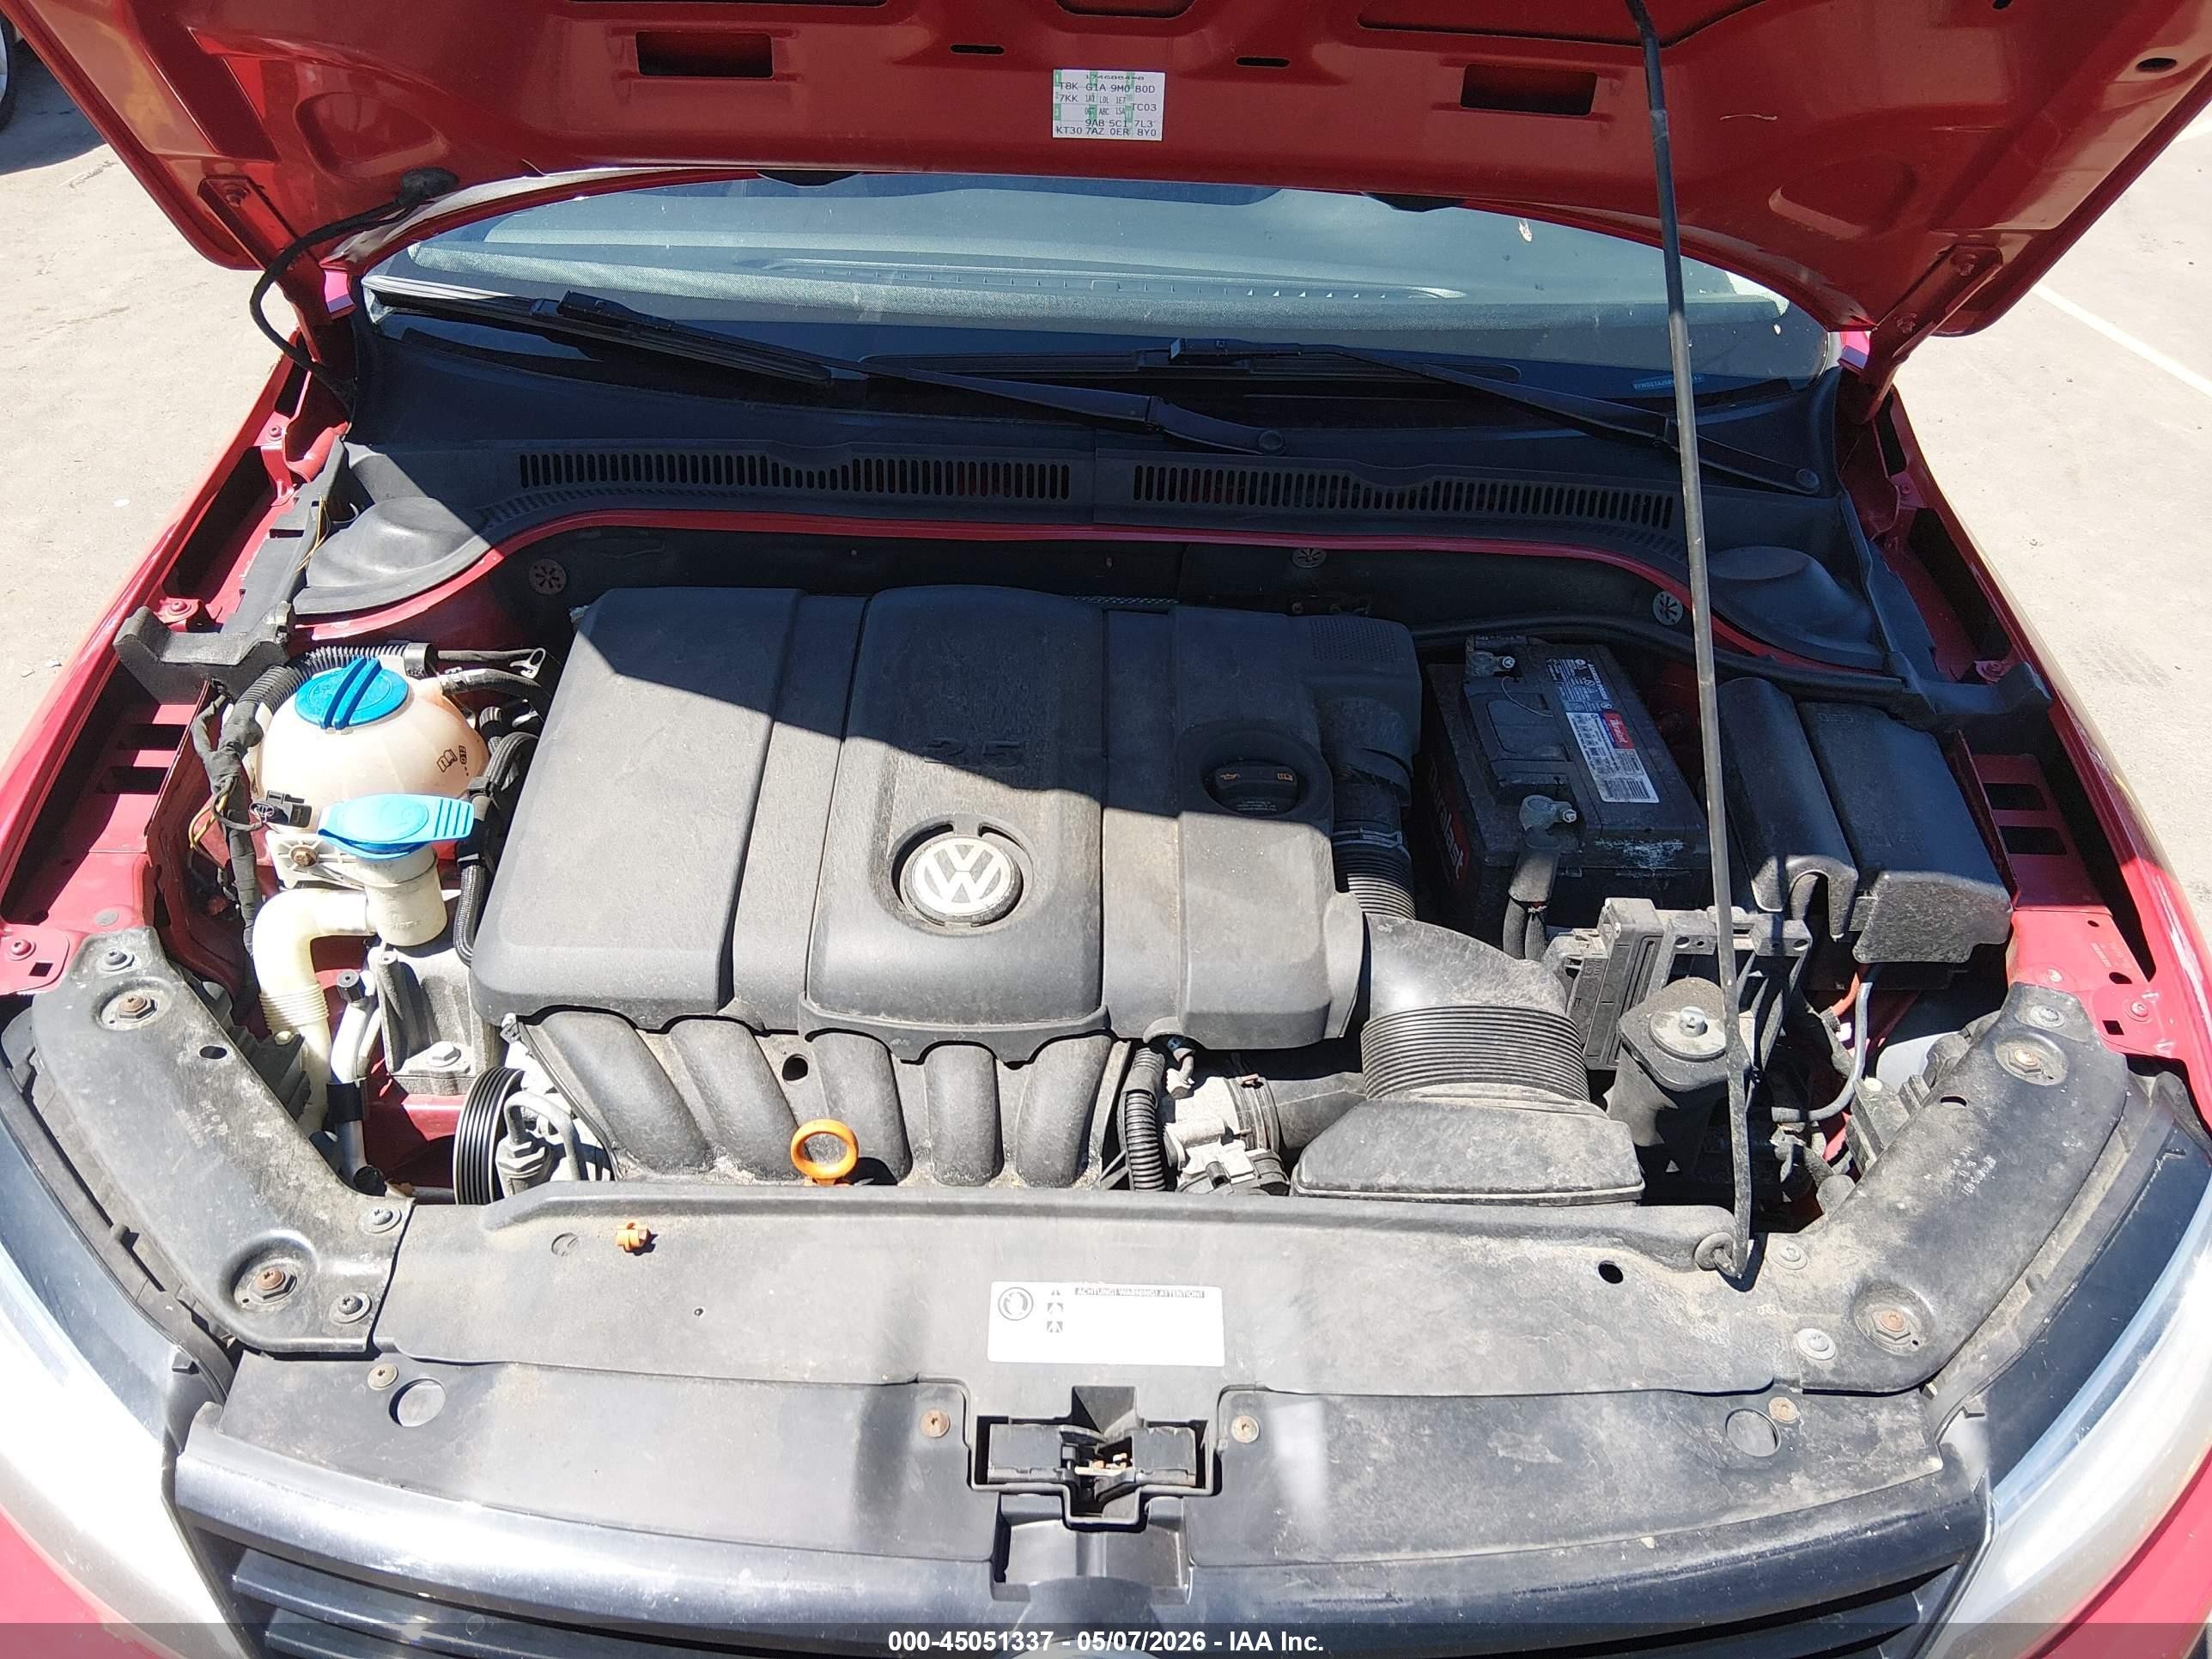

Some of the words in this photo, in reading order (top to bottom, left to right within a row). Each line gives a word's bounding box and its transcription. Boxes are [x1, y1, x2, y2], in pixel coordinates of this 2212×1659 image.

[1085, 83, 1106, 92] G1A
[1059, 94, 1079, 102] 7KK
[1131, 103, 1157, 112] TC03
[1085, 118, 1105, 127] 9AB
[1056, 126, 1083, 135] KT30
[913, 837, 1012, 914] VW
